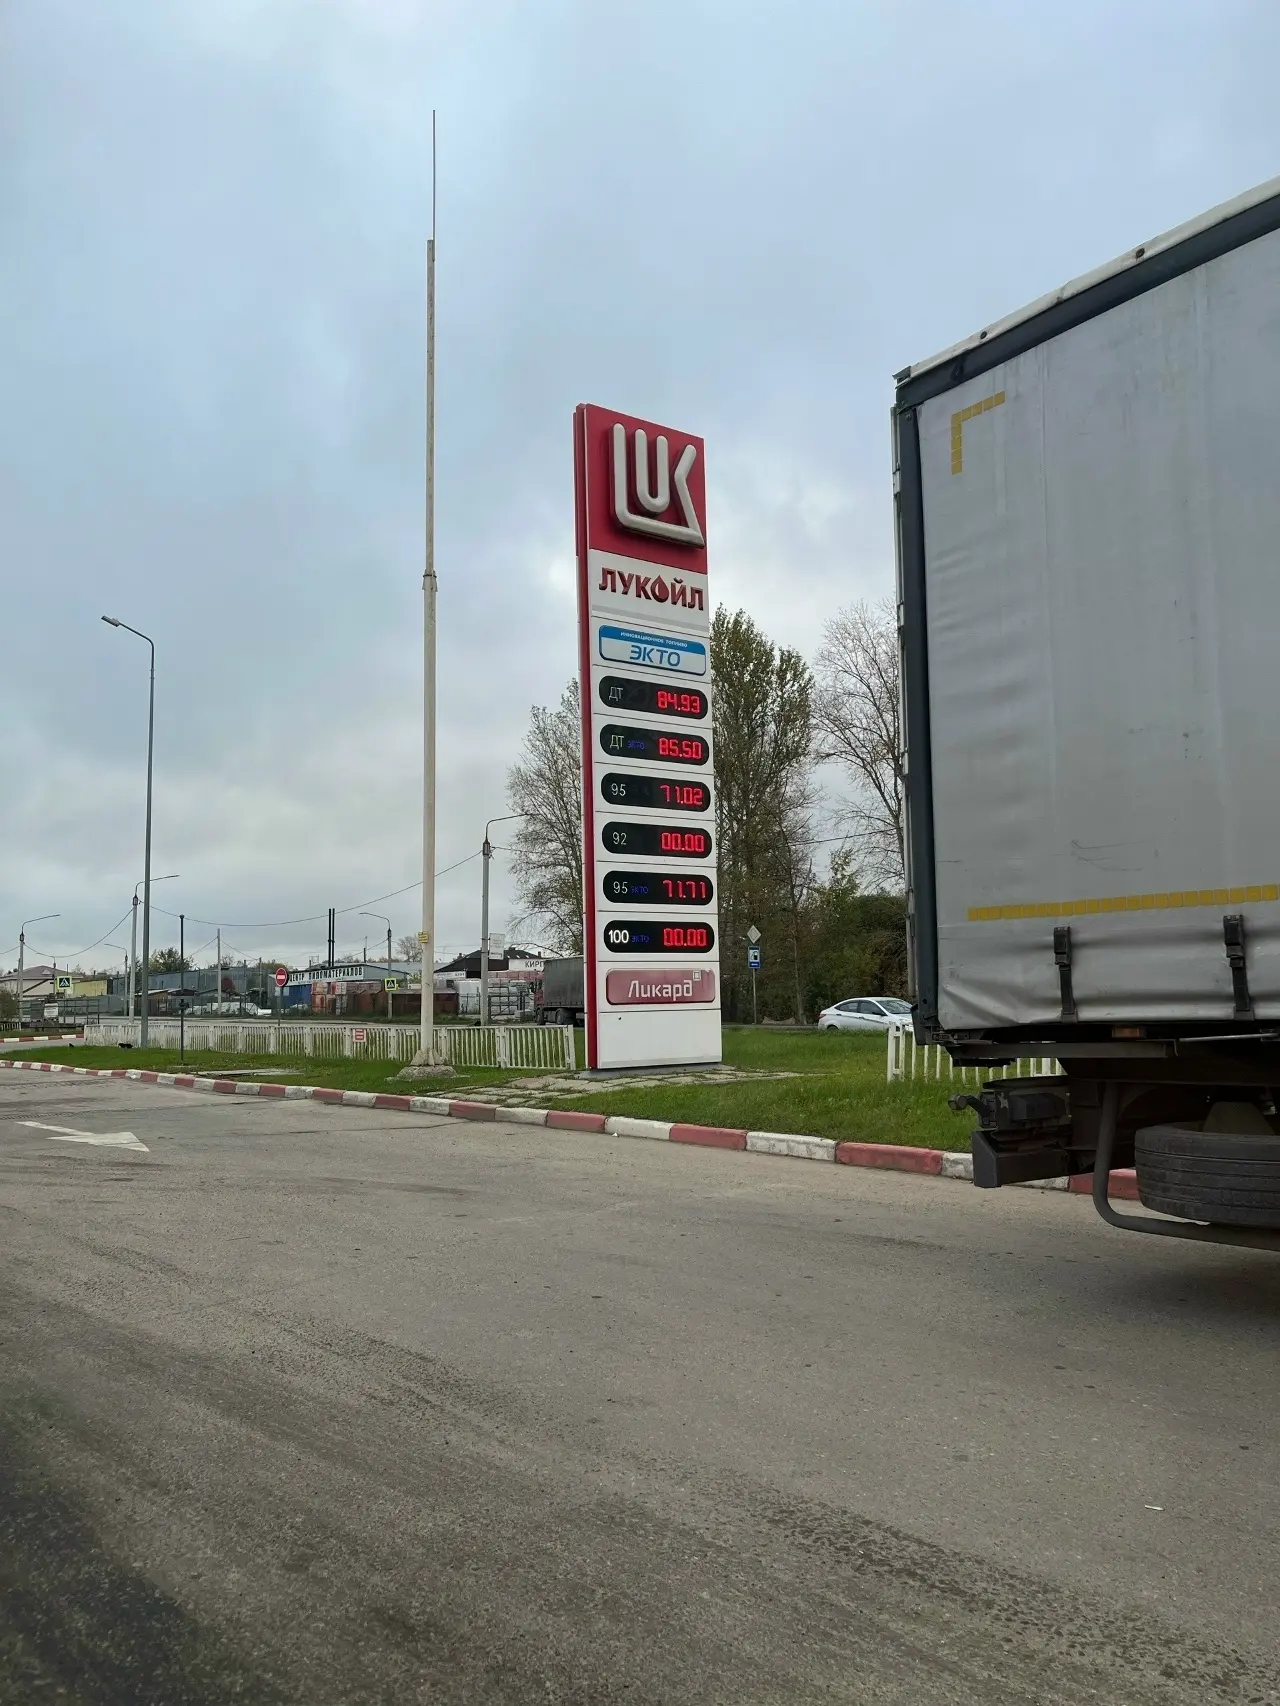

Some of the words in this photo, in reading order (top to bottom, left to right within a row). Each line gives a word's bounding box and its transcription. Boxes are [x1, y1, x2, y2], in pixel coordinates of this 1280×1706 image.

[599, 567, 703, 611] ЛУКОЙЛ
[630, 645, 681, 667] ЭКТО
[609, 687, 623, 701] ДТ
[657, 690, 700, 714] 84.93
[610, 735, 625, 750] ДТ
[627, 740, 645, 750] ЭКТО
[658, 738, 702, 760] 85.50
[611, 783, 626, 796] 95
[660, 785, 703, 806] 71.02
[612, 832, 627, 845] 92
[661, 833, 705, 852] 00.00
[613, 881, 628, 894] 95
[631, 885, 649, 894] ЭКТО
[662, 880, 706, 899] 71.71
[608, 929, 629, 943] 100
[663, 928, 707, 947] 00.00
[628, 980, 693, 1002] Ликард
